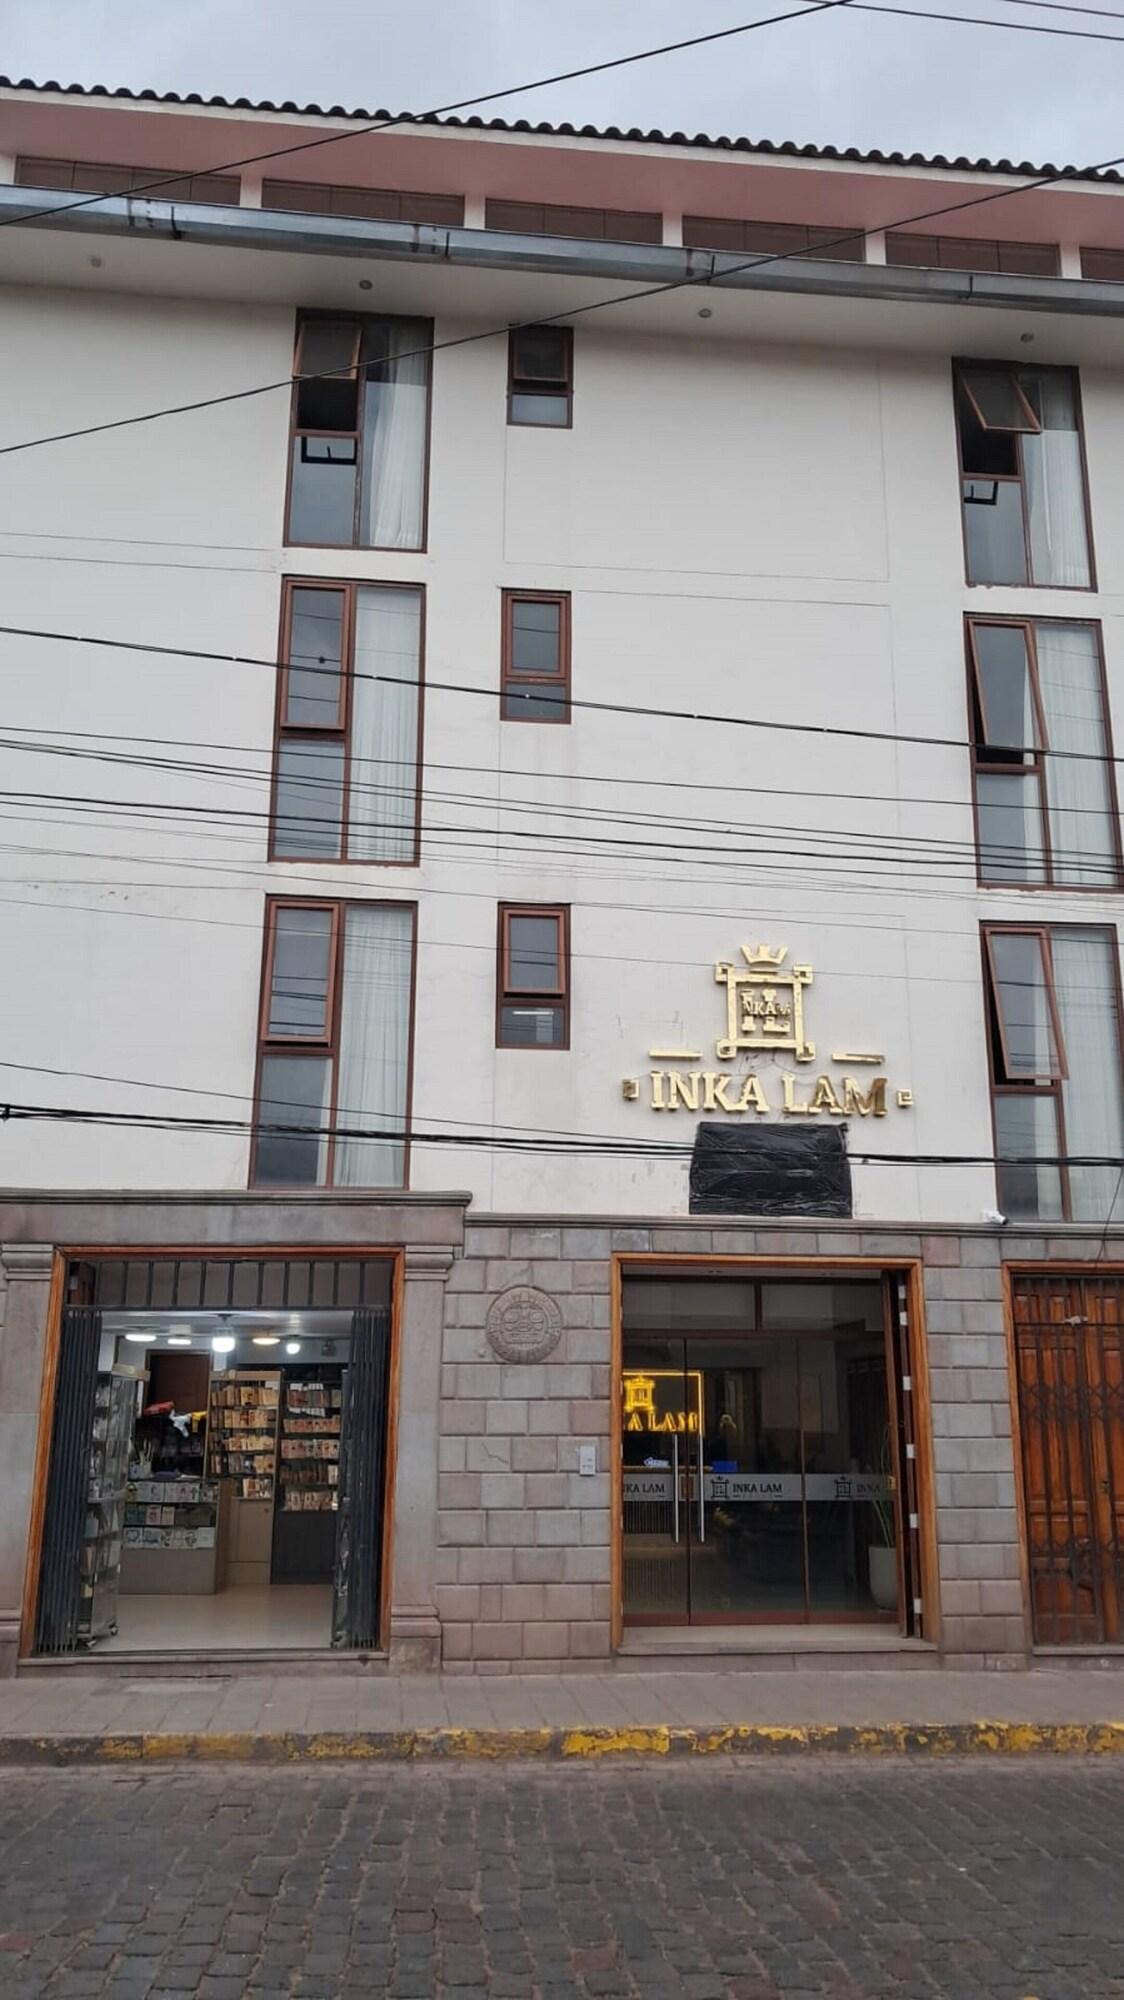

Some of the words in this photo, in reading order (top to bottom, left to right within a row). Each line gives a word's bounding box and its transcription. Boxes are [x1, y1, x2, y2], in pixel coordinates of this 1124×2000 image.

[650, 1070, 769, 1113] INKA
[781, 1074, 888, 1117] LAM
[622, 1483, 640, 1493] KA
[642, 1483, 665, 1493] LAM
[732, 1483, 757, 1493] INKA
[760, 1483, 783, 1493] LAM
